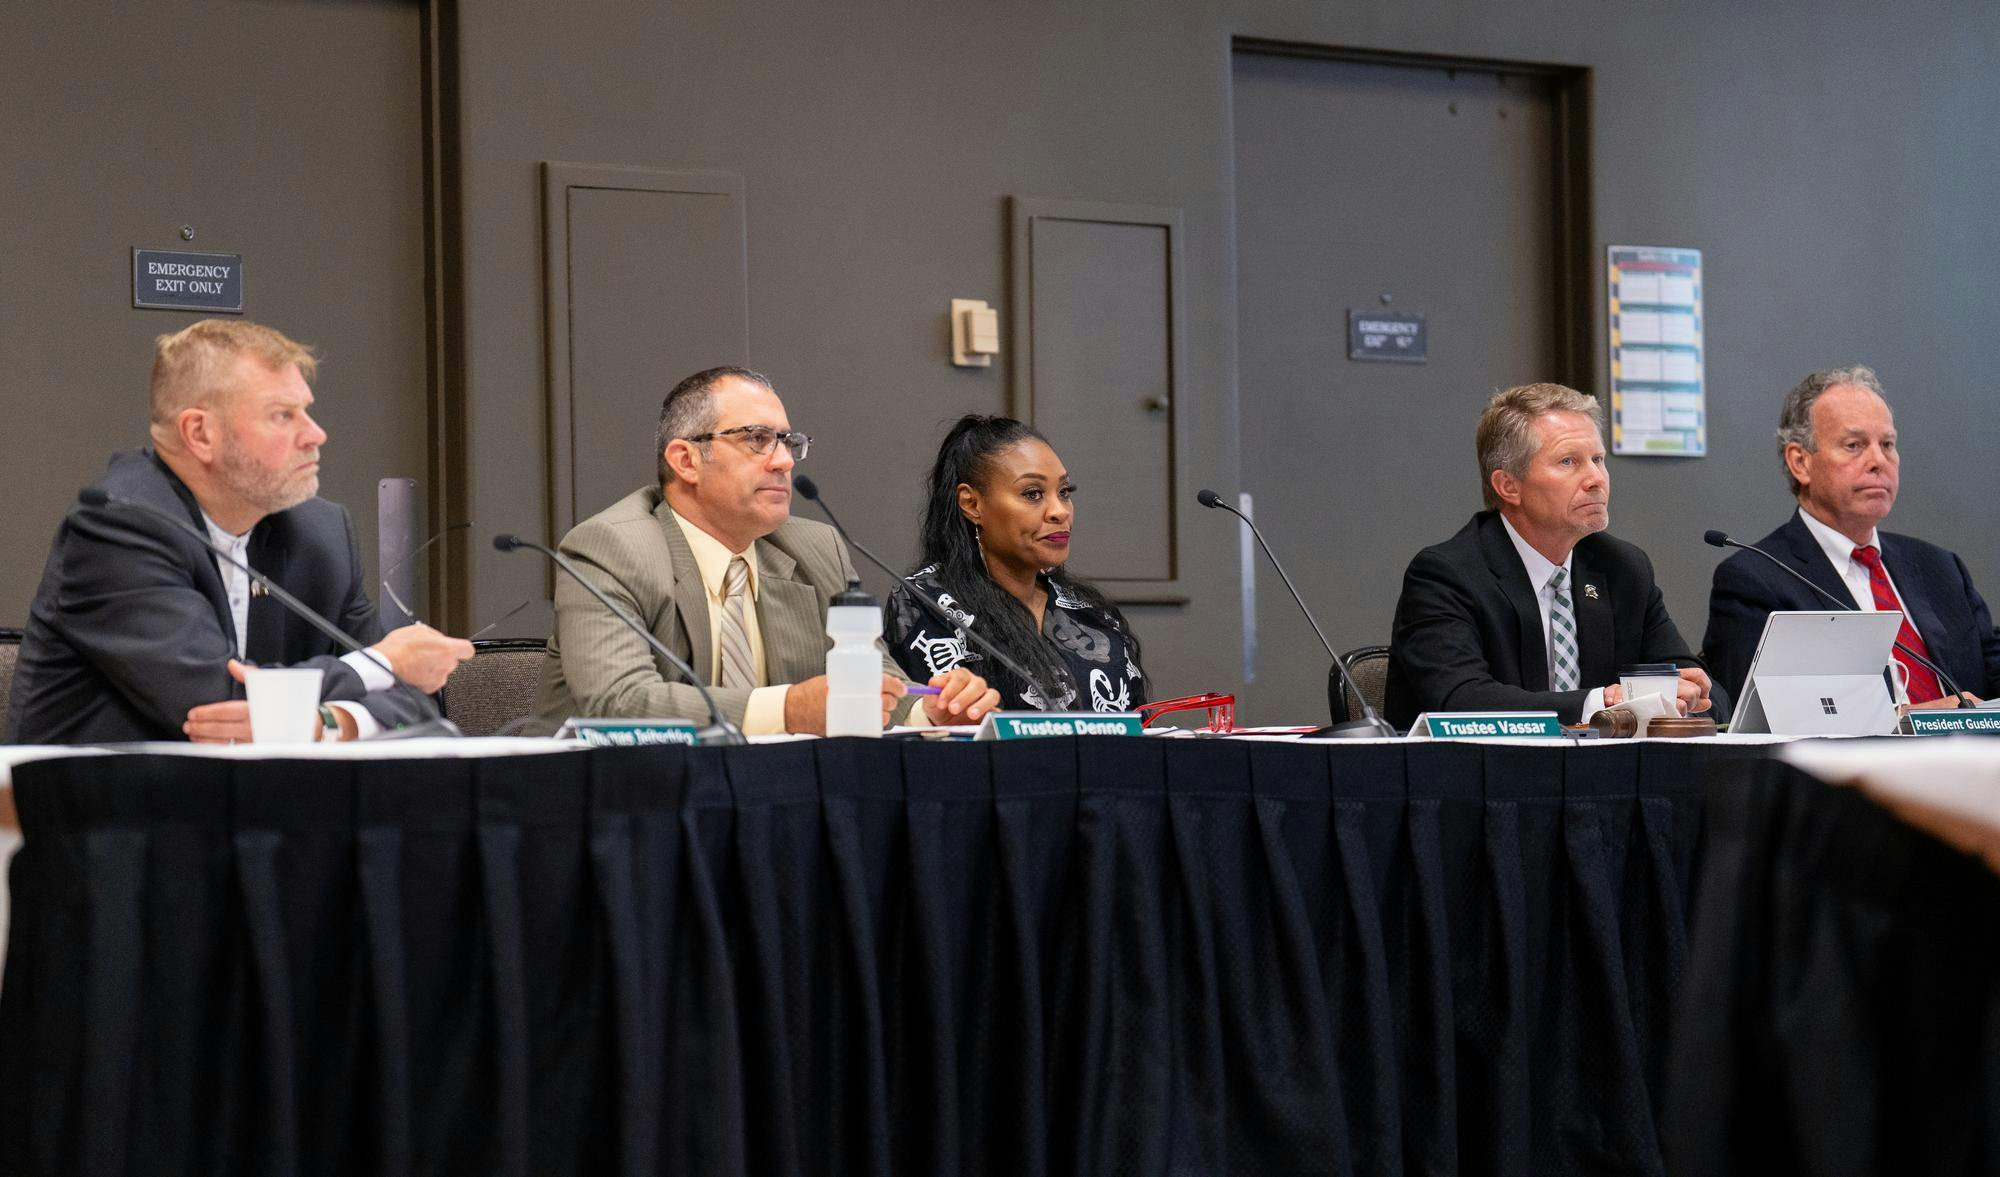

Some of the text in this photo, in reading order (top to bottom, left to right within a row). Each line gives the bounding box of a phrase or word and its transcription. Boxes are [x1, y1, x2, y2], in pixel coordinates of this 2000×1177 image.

[148, 262, 230, 278] EMERGENCY
[155, 279, 223, 294] EXIT ONLY
[1009, 719, 1127, 736] Trustee Denno
[1440, 720, 1546, 735] Trustee Vassar
[1914, 717, 2000, 731] President Guskie
